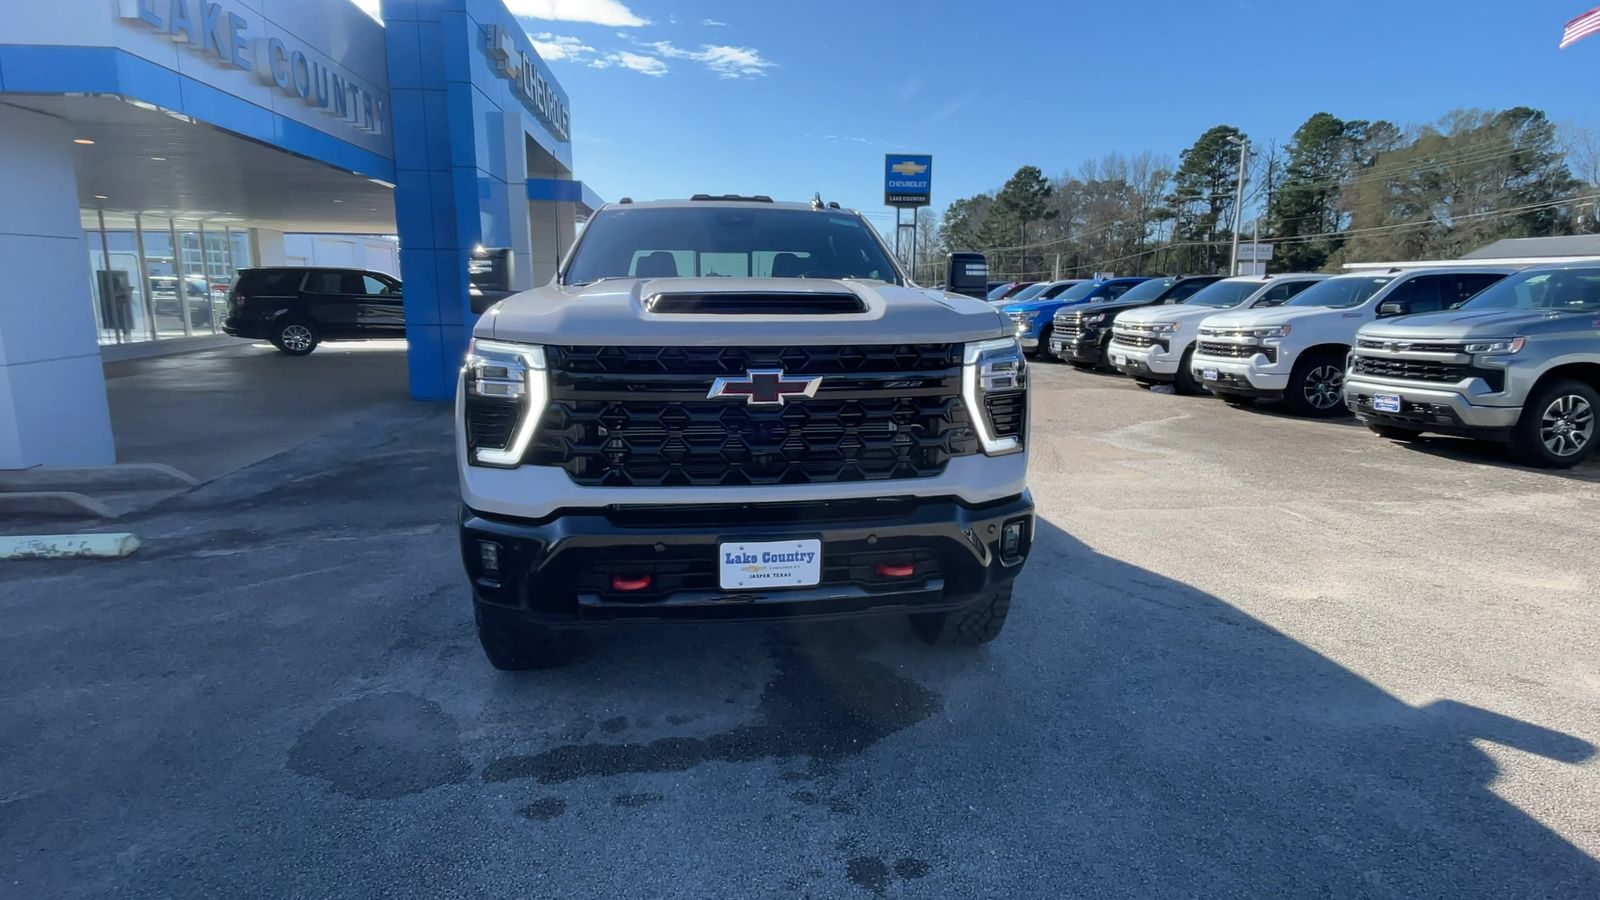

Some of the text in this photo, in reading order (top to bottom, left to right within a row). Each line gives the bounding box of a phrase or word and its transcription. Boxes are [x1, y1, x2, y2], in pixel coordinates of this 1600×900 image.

[120, 0, 386, 136] LAKE COUNTRY
[521, 50, 569, 140] CHEVROLET
[725, 550, 815, 564] Lake Country
